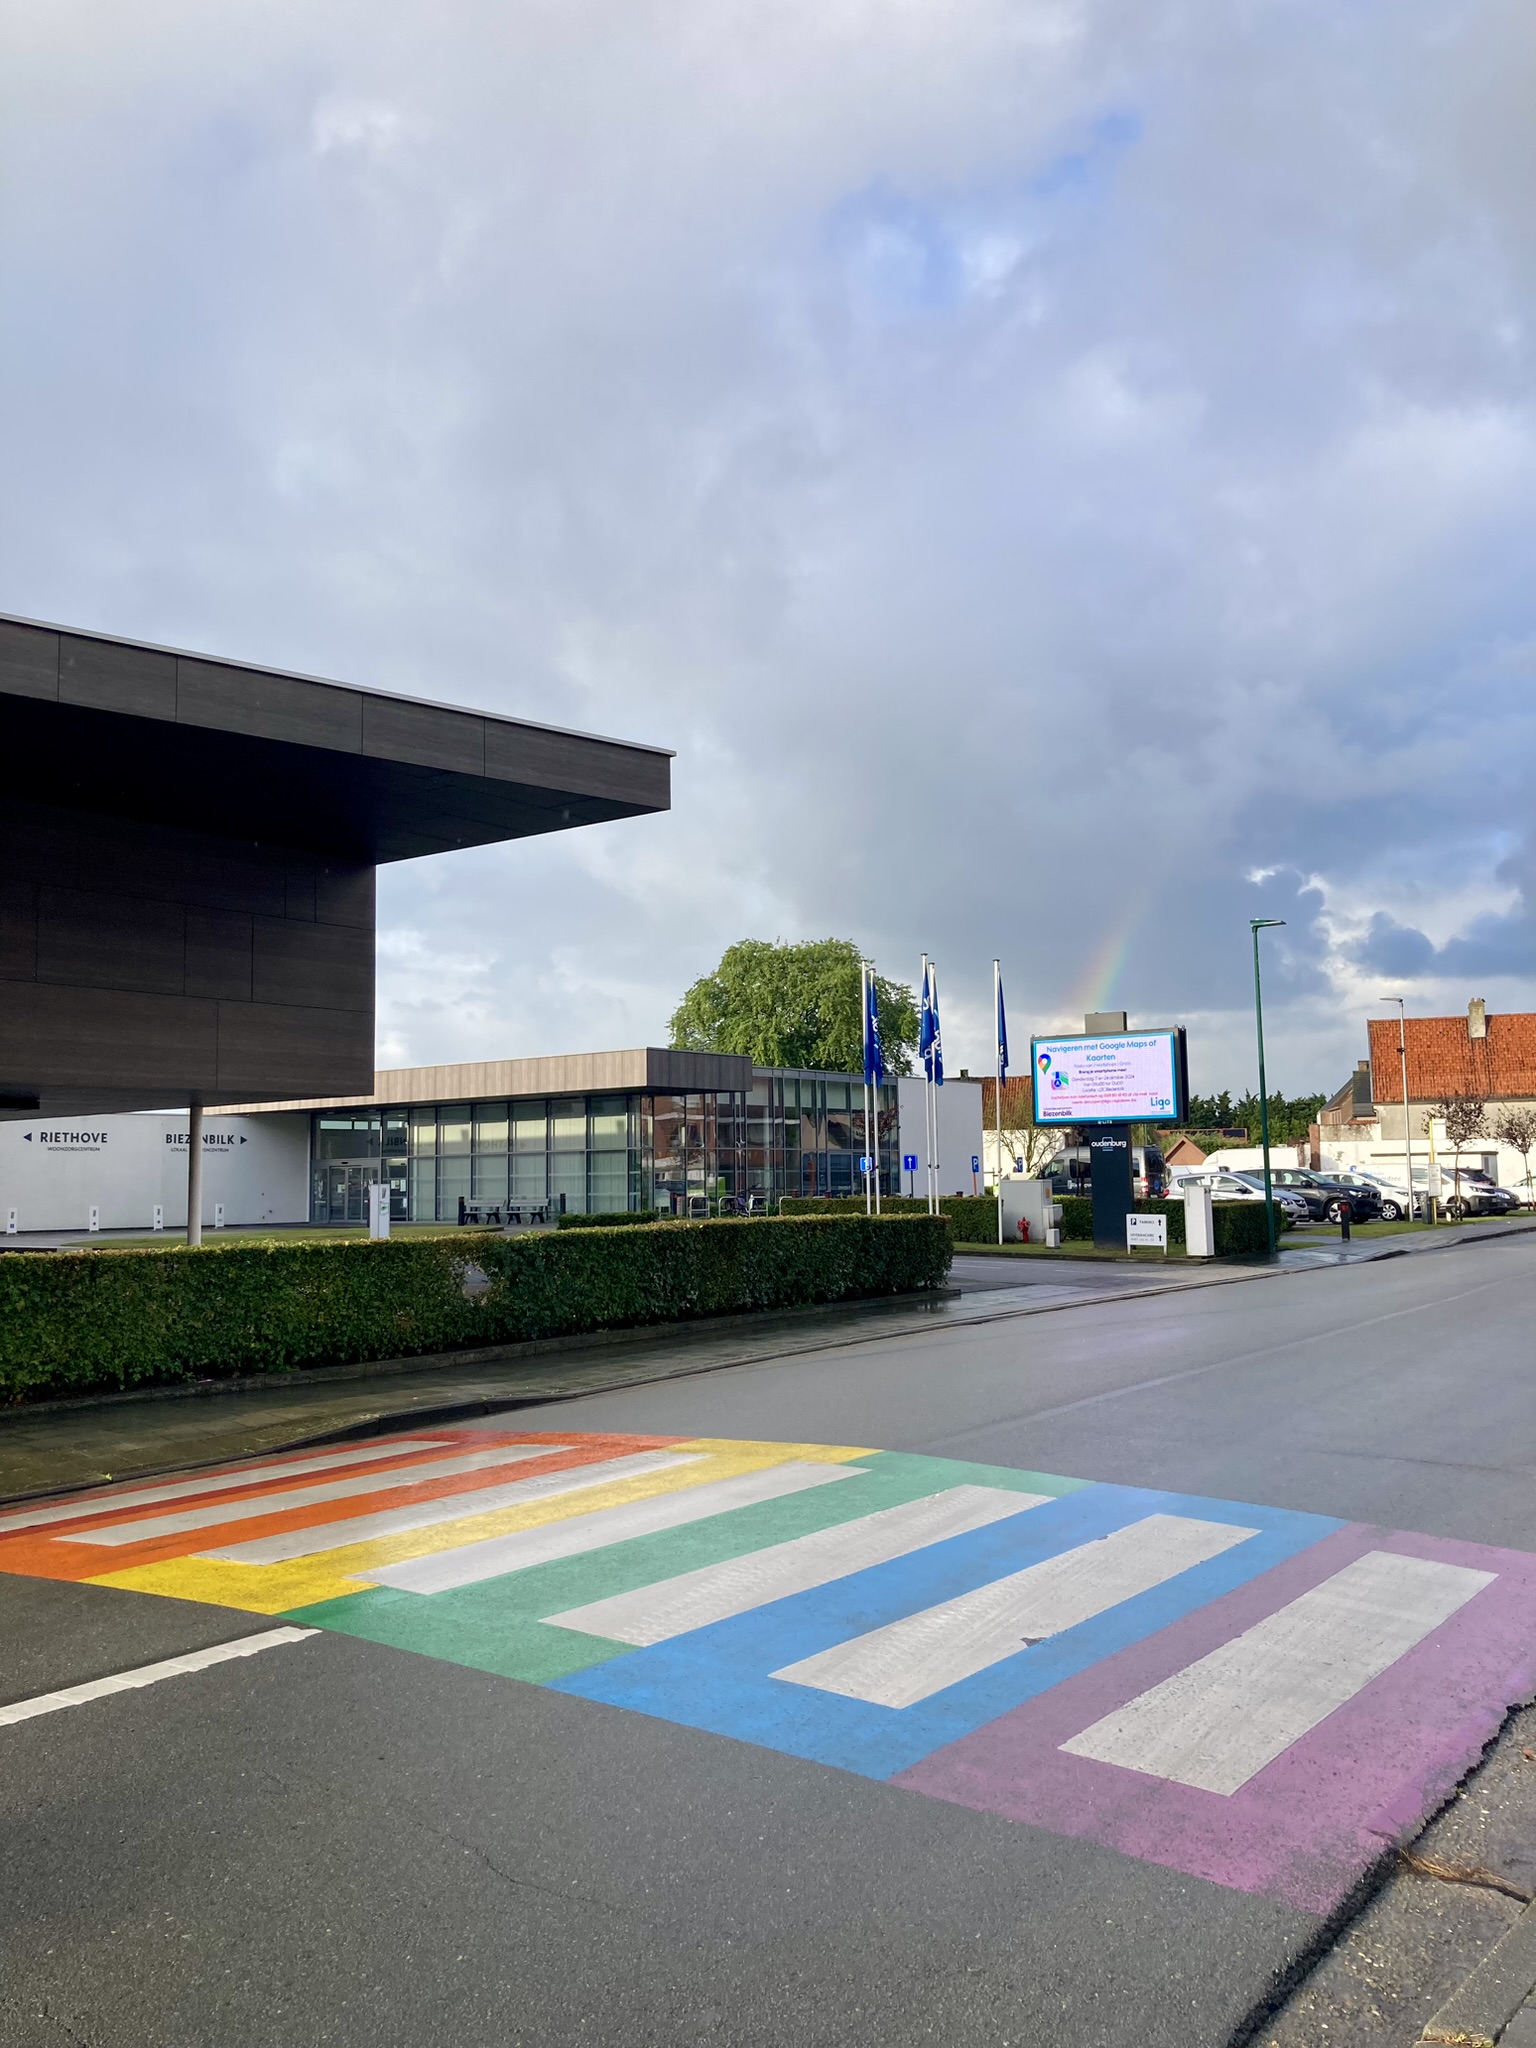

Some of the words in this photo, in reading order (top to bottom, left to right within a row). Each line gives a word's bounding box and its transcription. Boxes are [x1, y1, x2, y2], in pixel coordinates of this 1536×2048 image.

[1046, 1046, 1082, 1054] Navigeren
[1100, 1042, 1124, 1051] Google
[1126, 1041, 1147, 1049] Maps
[1086, 1054, 1116, 1062] Kaarten
[1150, 1097, 1170, 1110] Ligo
[40, 1132, 108, 1143] RIETHOVE
[1091, 1138, 1126, 1148] oudenburg
